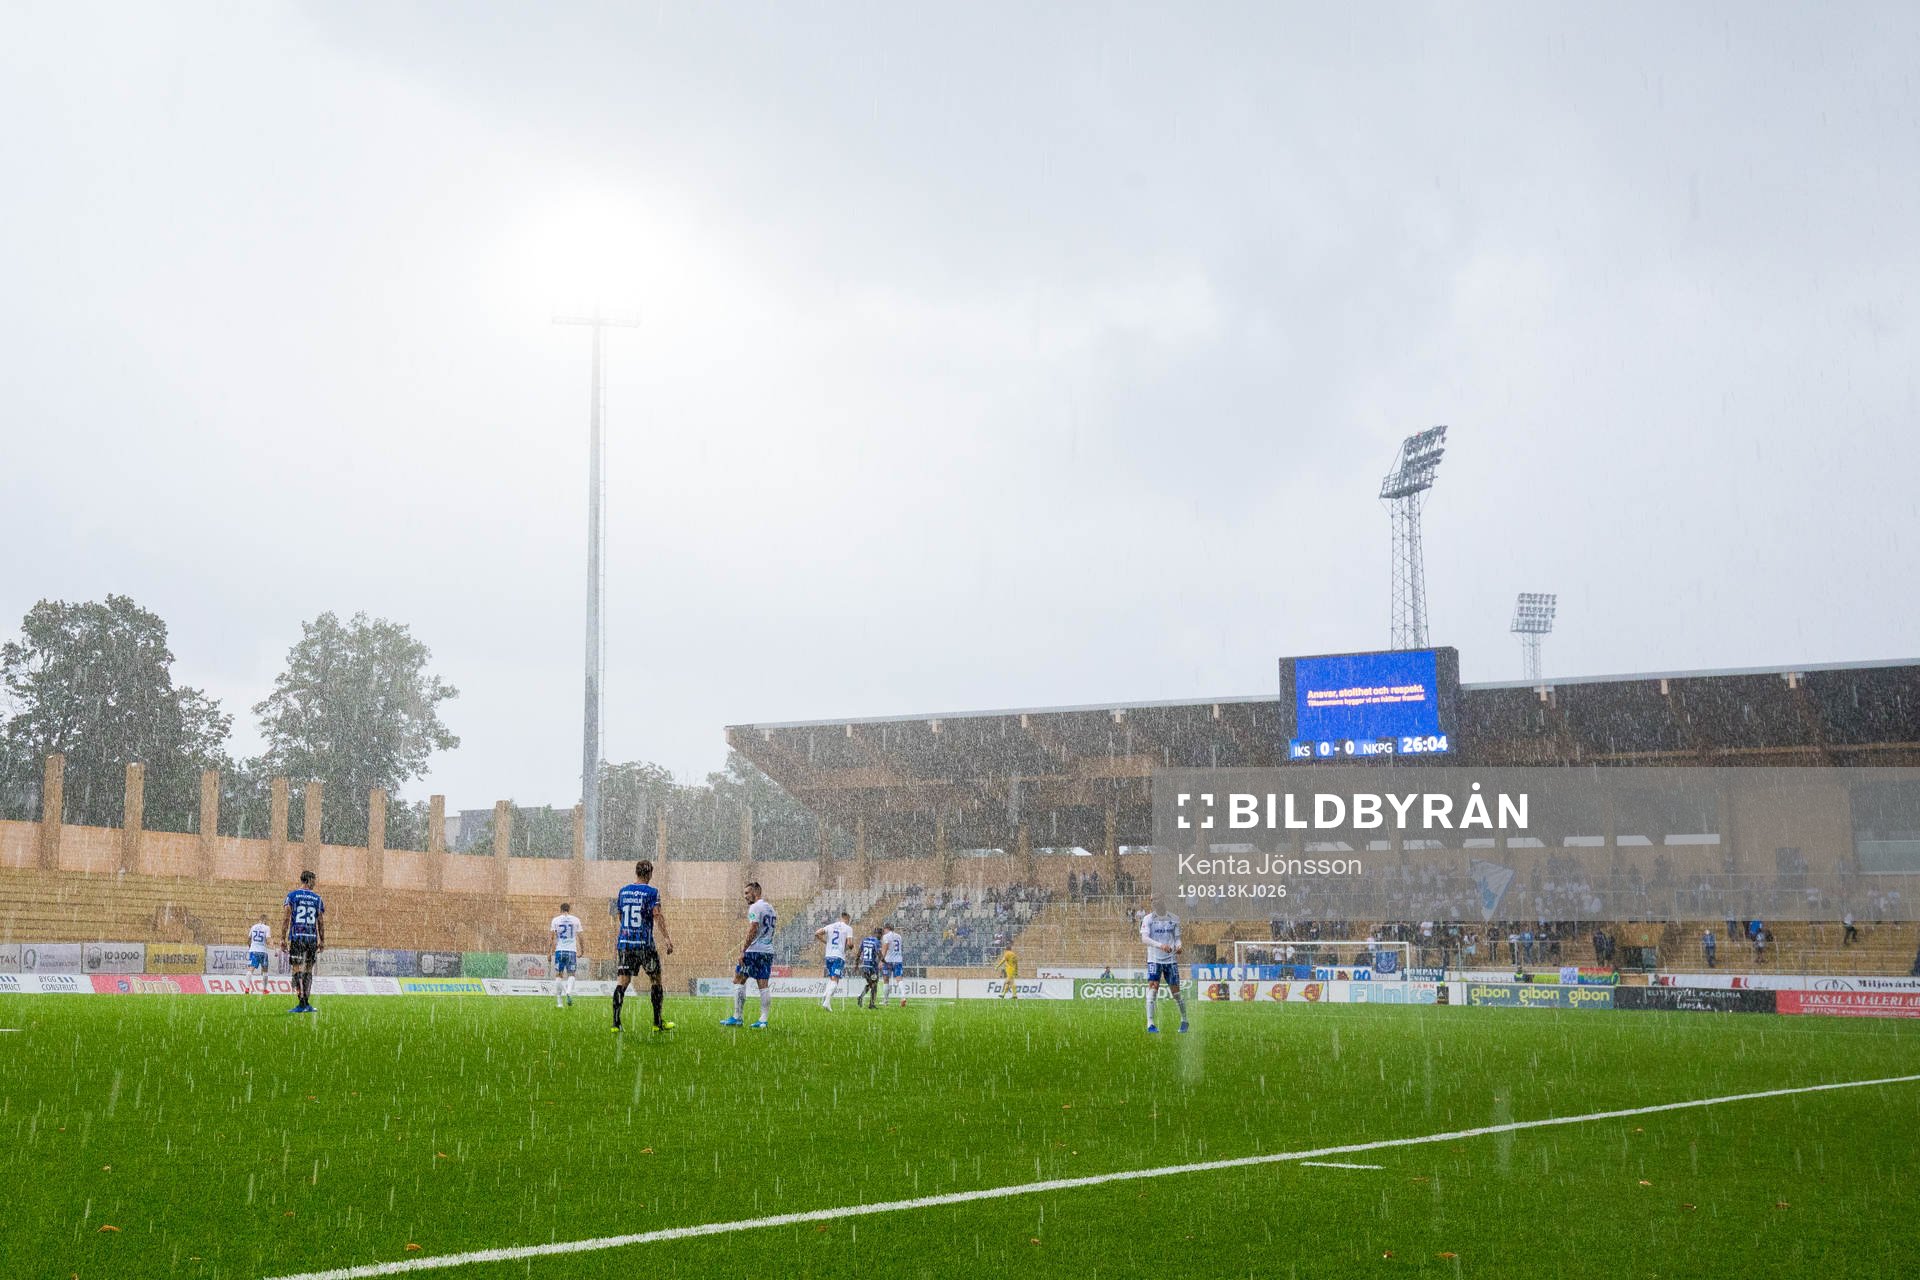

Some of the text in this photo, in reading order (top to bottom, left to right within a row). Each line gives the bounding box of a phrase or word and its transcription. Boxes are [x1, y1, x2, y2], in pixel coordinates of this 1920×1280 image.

[1373, 686, 1389, 695] och
[1294, 745, 1311, 757] IKS
[1320, 742, 1330, 755] 0
[1345, 740, 1355, 754] 0
[1362, 742, 1393, 754] NKPG
[1402, 735, 1449, 753] 26:04
[295, 905, 317, 925] 23
[622, 904, 643, 928] 15
[252, 930, 265, 943] 25
[558, 924, 574, 939] 21
[831, 930, 840, 946] 2
[893, 939, 900, 952] 3
[863, 947, 873, 960] 21
[39, 975, 57, 983] BYGG
[41, 983, 79, 992] CONSTRUCT
[208, 979, 237, 993] RA
[1471, 985, 1511, 1006] gibon
[1519, 986, 1560, 1007] gibon
[1568, 987, 1610, 1008] gibon
[1699, 990, 1742, 999] ACADEMIA
[1799, 993, 1852, 1005] VAKSALA
[1676, 1002, 1712, 1010] UPPSALA
